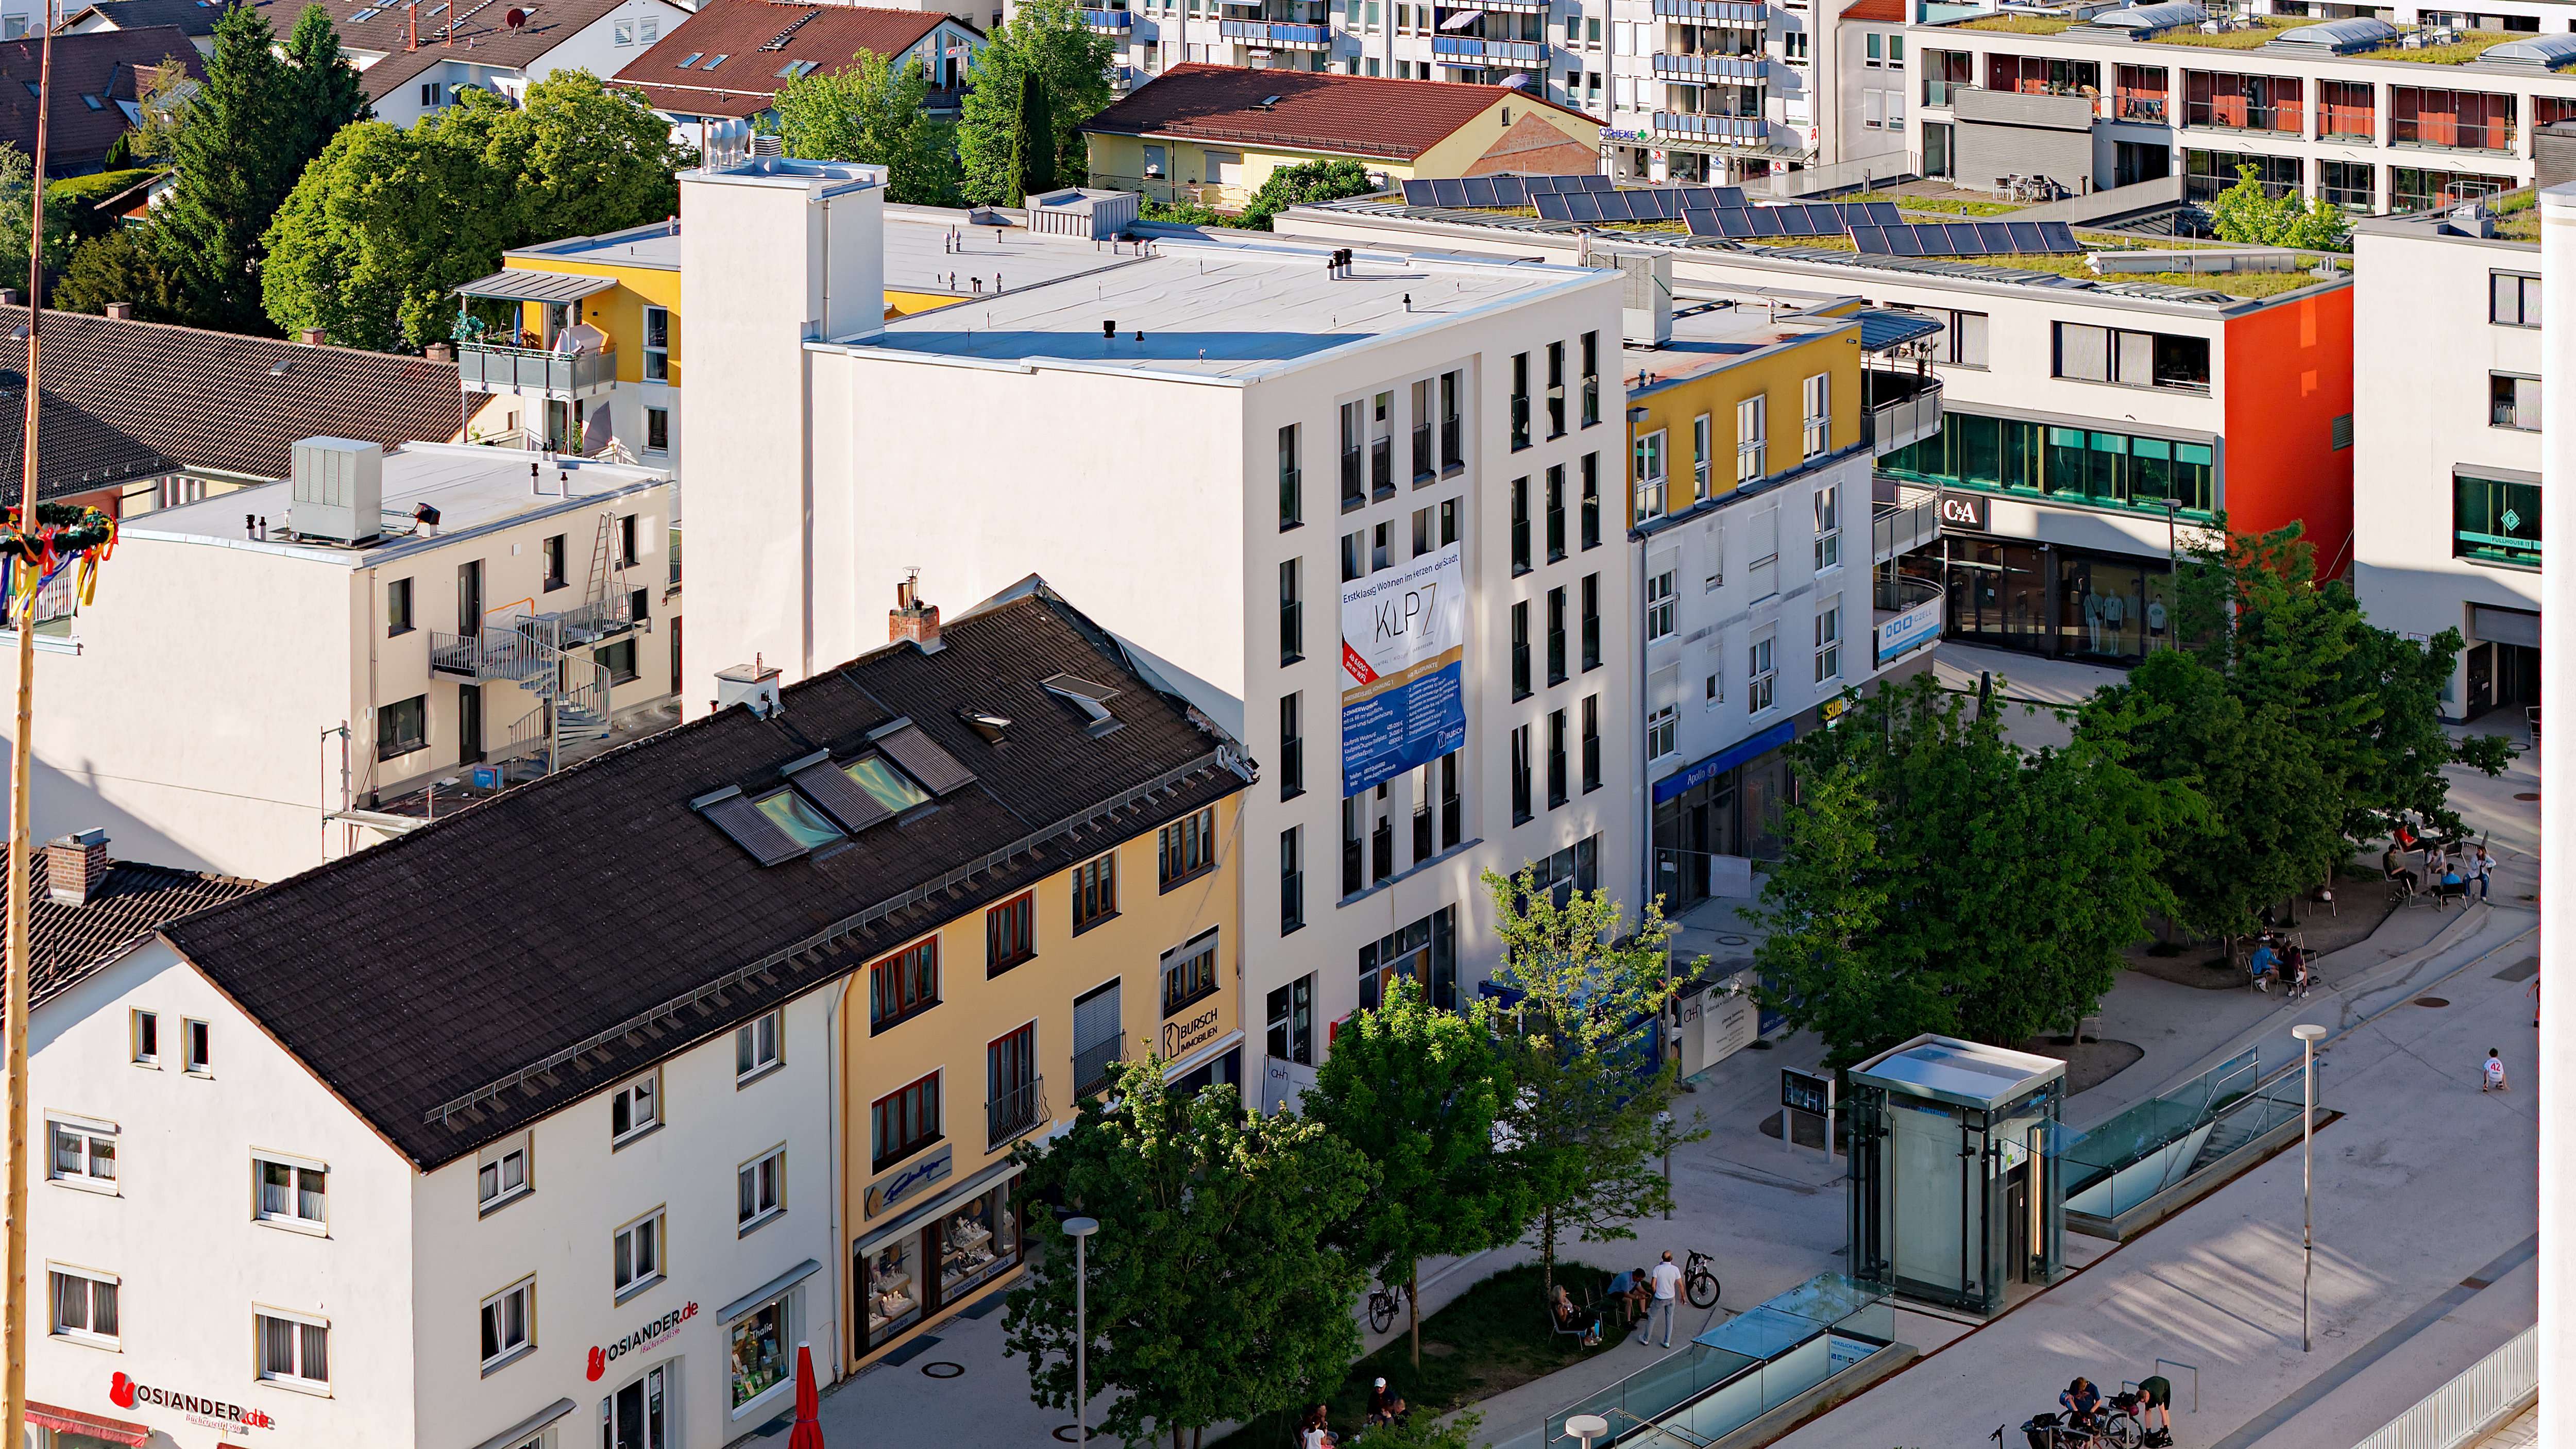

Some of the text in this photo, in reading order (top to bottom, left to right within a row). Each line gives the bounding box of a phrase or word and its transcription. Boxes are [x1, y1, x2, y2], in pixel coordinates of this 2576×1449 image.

[1943, 499, 1978, 524] C&A
[2492, 537, 2524, 546] FULLHOUSE
[1377, 576, 1404, 592] Wohnen
[1404, 573, 1413, 582] im
[1687, 768, 1705, 786] Apollo
[1181, 1007, 1217, 1039] BURSCH
[1181, 1025, 1218, 1053] IMMOBILIEN
[2490, 1063, 2501, 1071] 42
[987, 1257, 1010, 1276] Schmuck
[953, 1276, 979, 1295] Mineralien
[752, 1322, 773, 1340] Thalia
[887, 1317, 908, 1335] Juwelen
[1831, 1339, 1853, 1349] HERZLICH
[185, 1413, 210, 1426] Bücher
